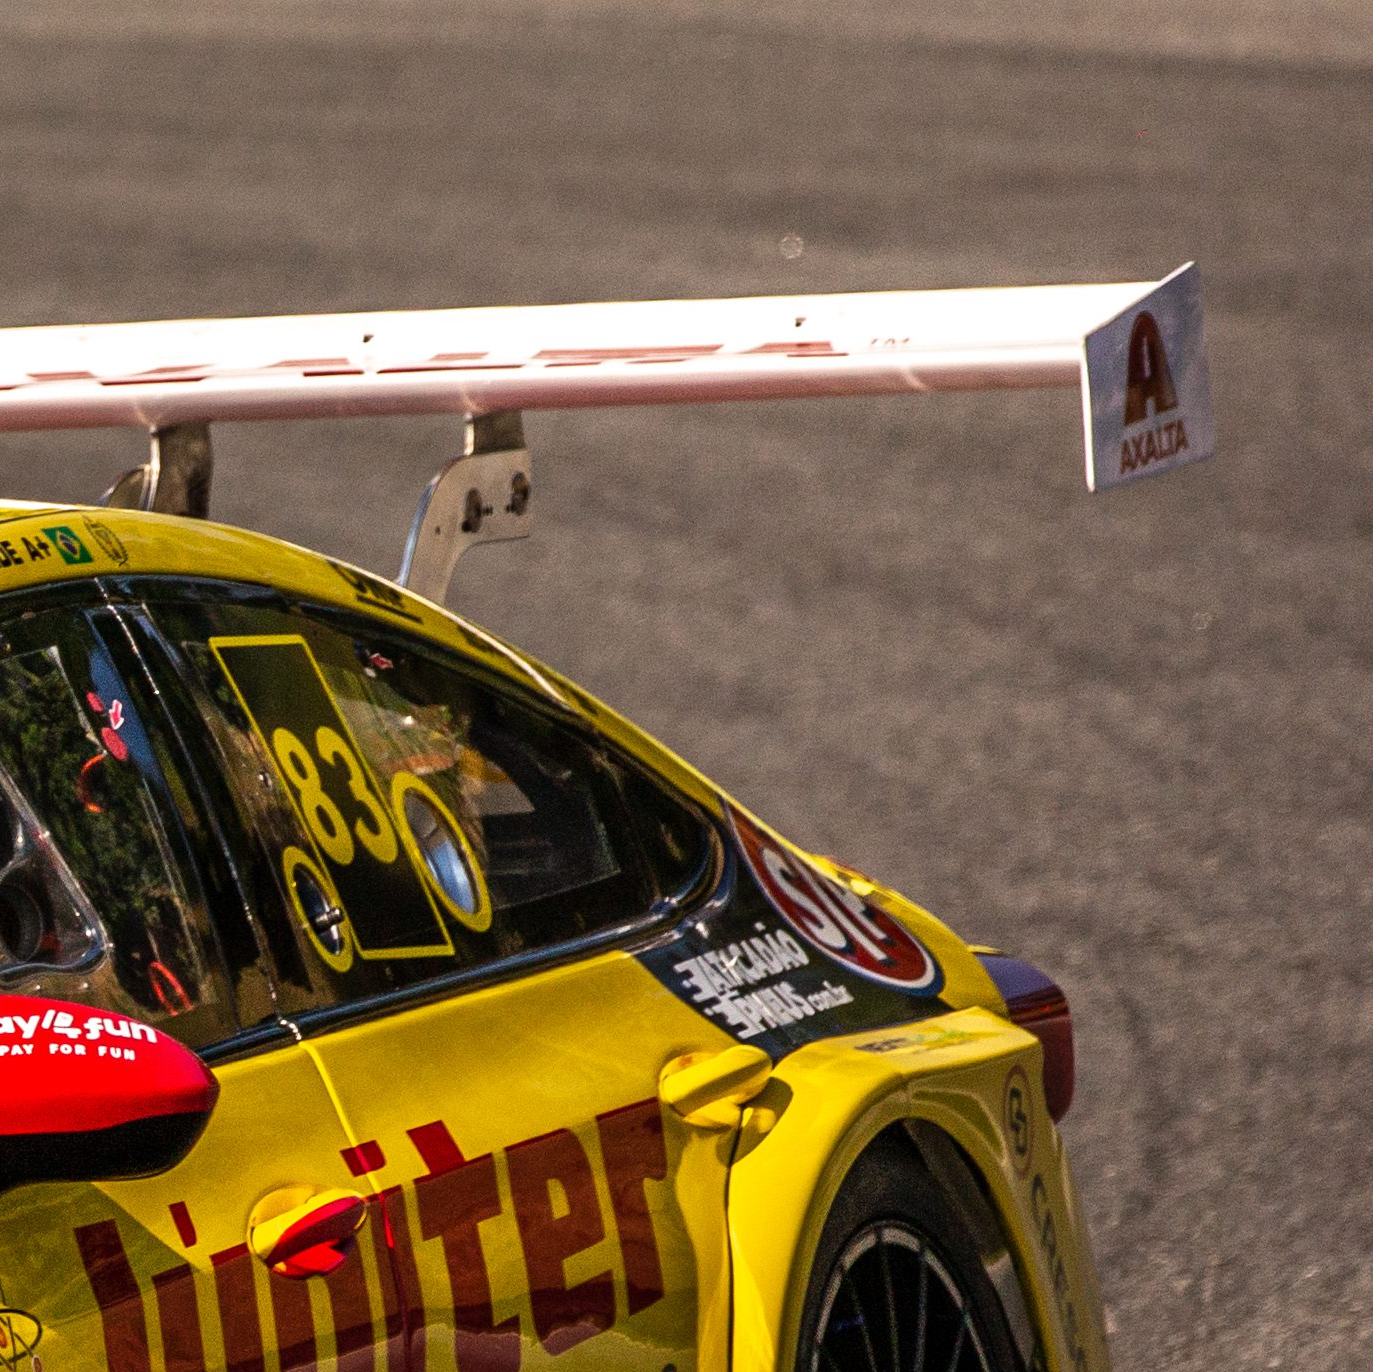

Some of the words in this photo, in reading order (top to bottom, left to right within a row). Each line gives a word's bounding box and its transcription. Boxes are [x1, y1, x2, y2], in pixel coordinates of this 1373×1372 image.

[1120, 419, 1190, 475] AXALTA
[21, 536, 52, 562] A+
[271, 725, 399, 866] 83
[49, 1043, 87, 1056] FOR
[97, 1045, 136, 1061] FUN
